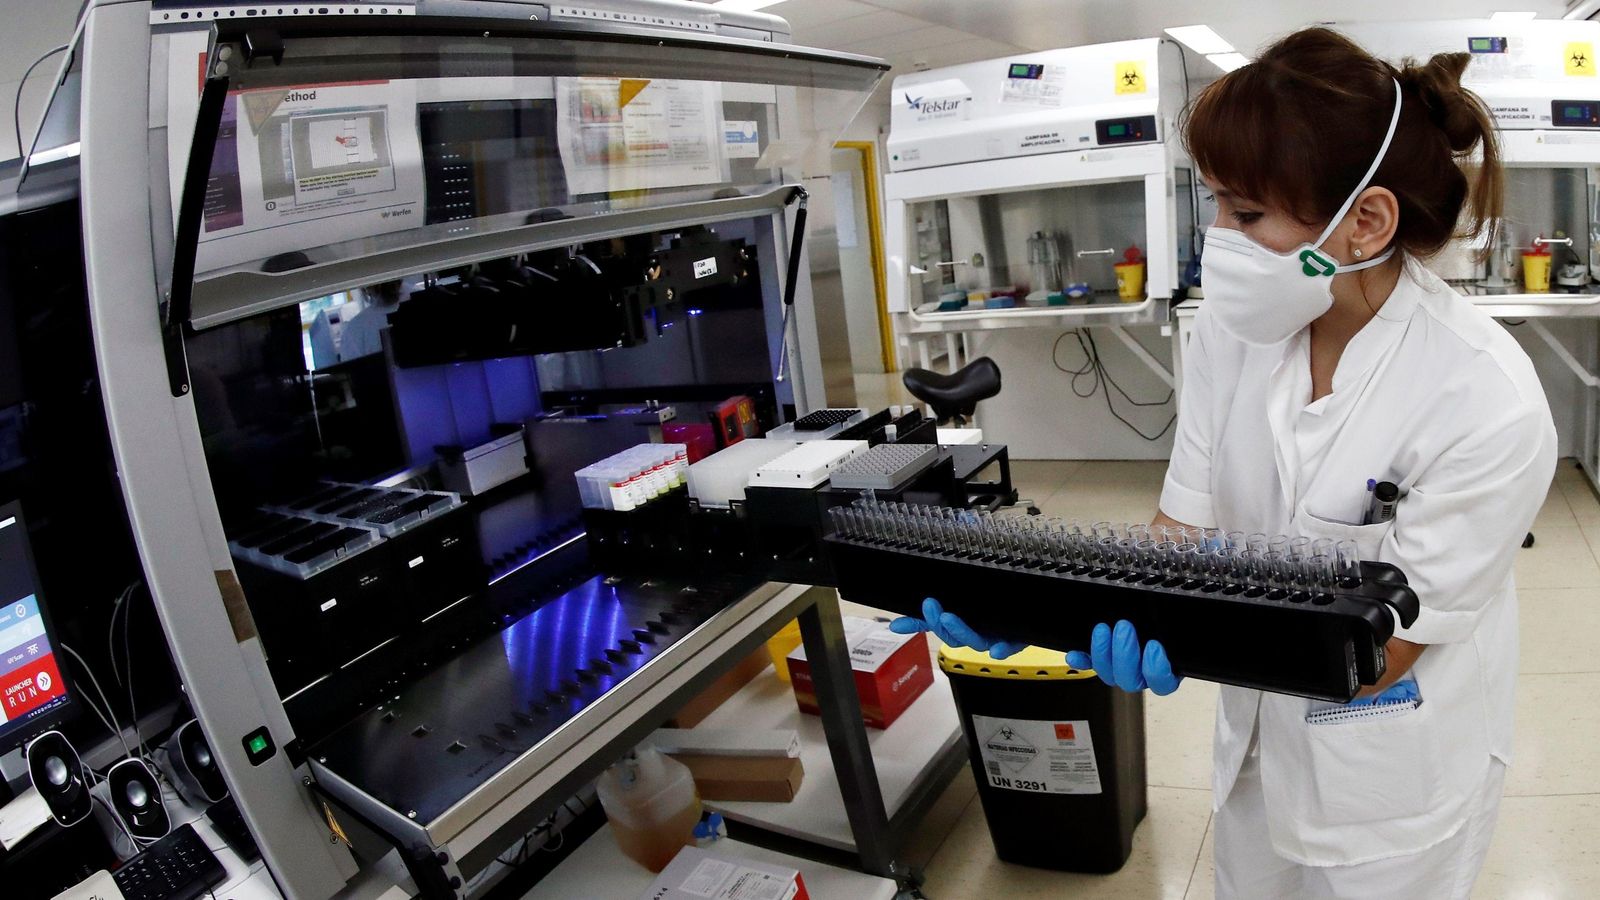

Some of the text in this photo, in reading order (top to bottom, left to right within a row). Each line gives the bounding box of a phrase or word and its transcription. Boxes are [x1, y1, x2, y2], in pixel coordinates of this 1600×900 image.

[284, 91, 316, 102] ethod
[921, 100, 961, 114] Telstar
[5, 677, 33, 696] LAUNCHER
[8, 686, 38, 708] RUN
[992, 776, 1012, 788] UN
[1015, 780, 1047, 792] 3291
